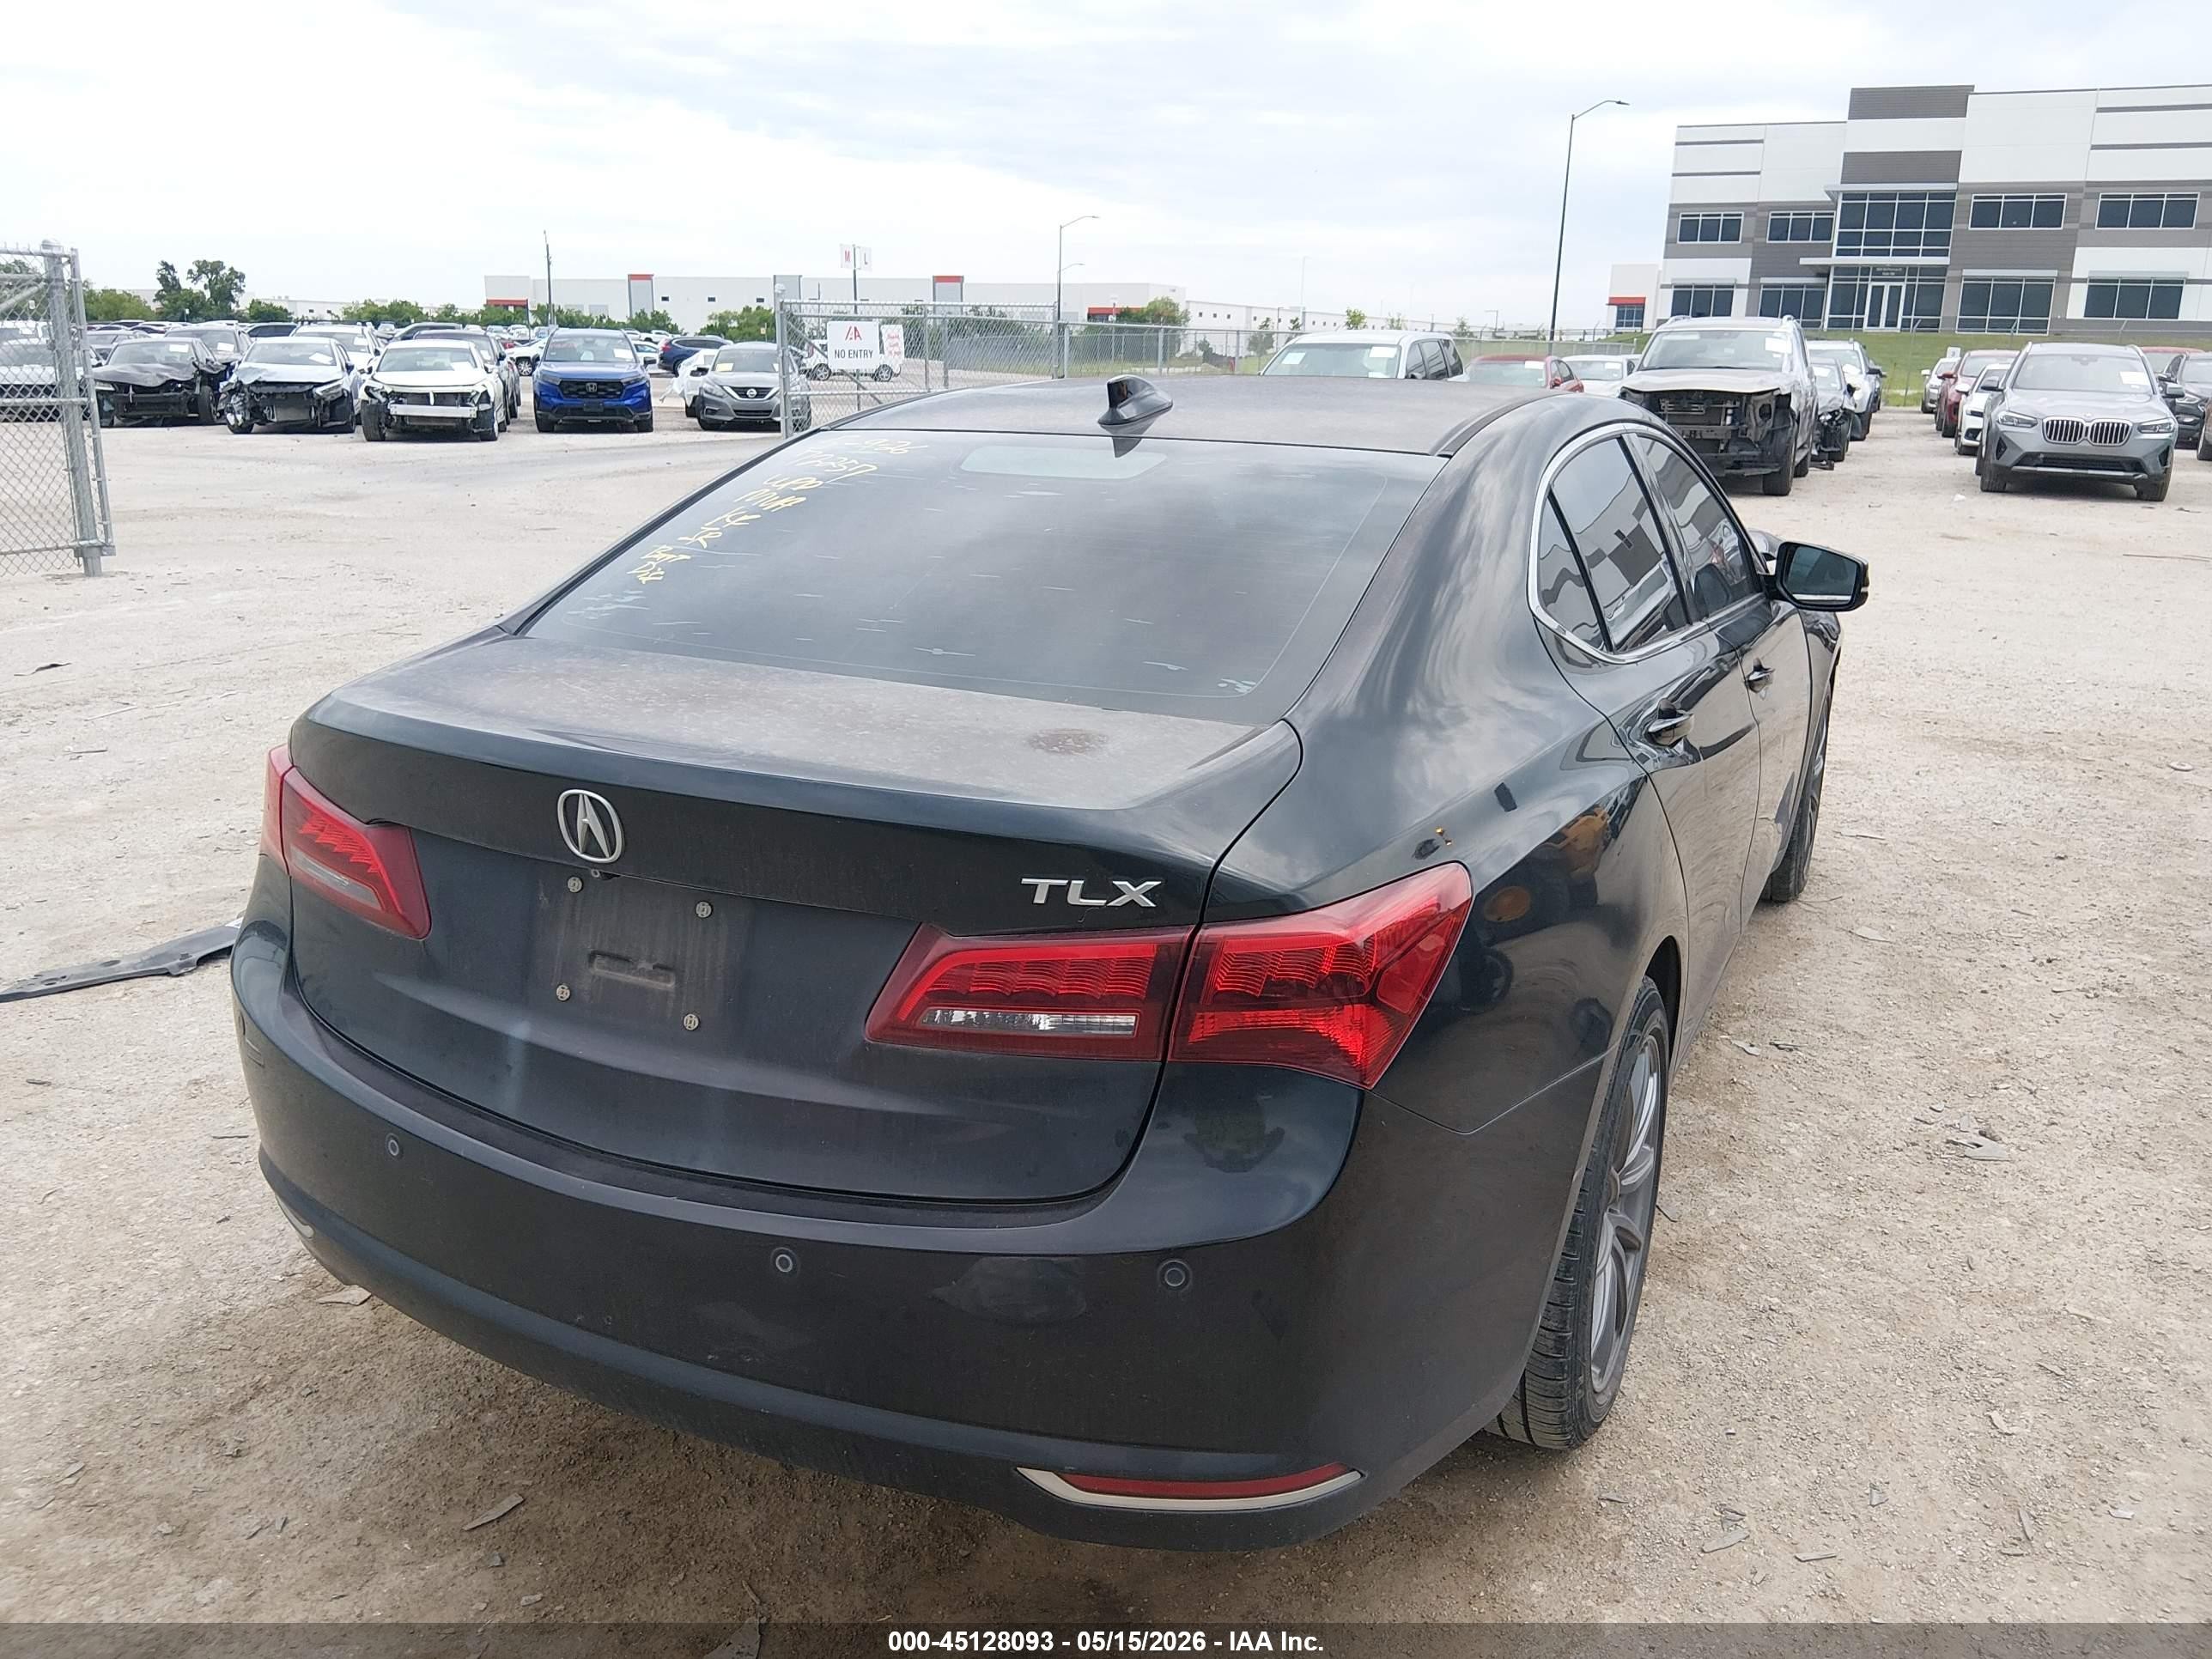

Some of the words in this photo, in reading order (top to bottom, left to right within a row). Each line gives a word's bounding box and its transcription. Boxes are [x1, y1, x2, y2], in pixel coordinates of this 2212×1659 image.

[844, 250, 851, 263] M
[834, 349, 846, 359] NO
[848, 349, 873, 359] ENTRY
[1020, 878, 1162, 908] TLX
